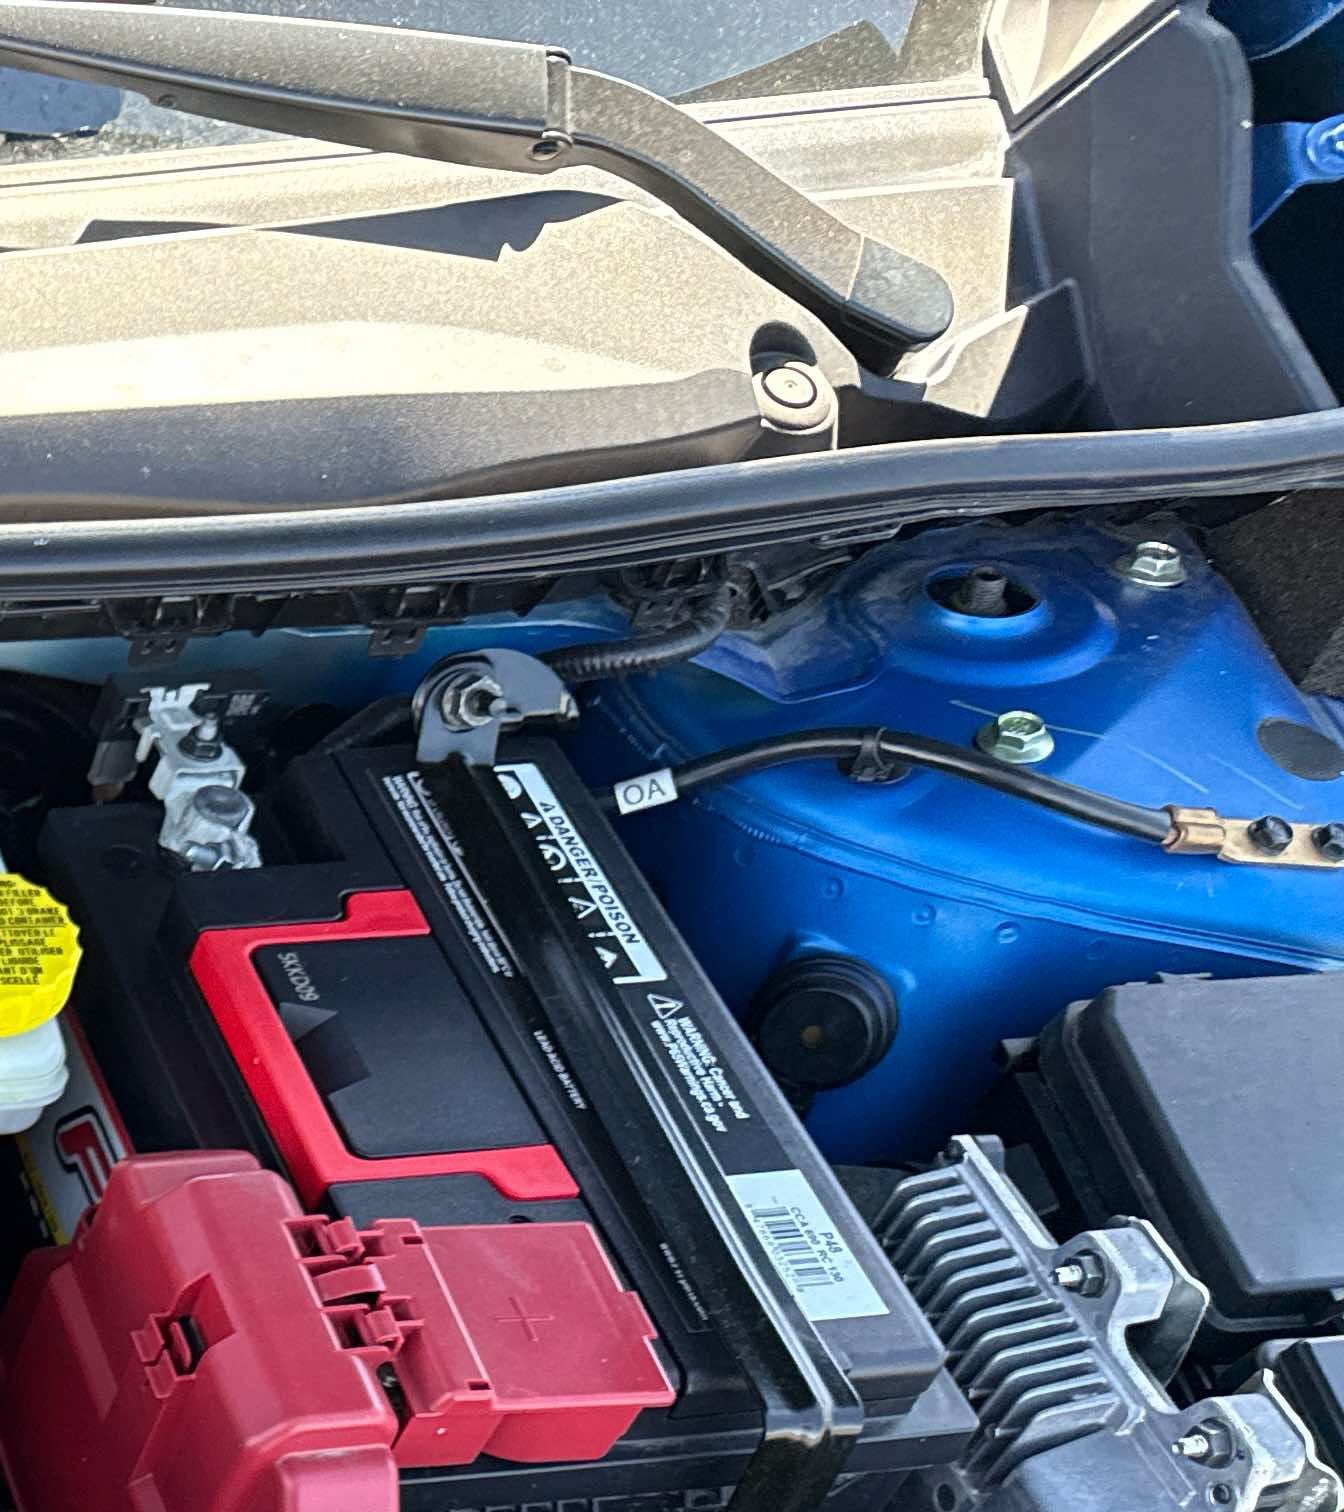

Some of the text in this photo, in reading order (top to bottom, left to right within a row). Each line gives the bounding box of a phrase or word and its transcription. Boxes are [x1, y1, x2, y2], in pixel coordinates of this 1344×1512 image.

[549, 815, 641, 945] DANGER/POISON
[664, 1018, 707, 1076] Reproductive
[700, 1076, 723, 1102] Harm
[709, 1067, 736, 1100] Cancer
[728, 1100, 751, 1119] and
